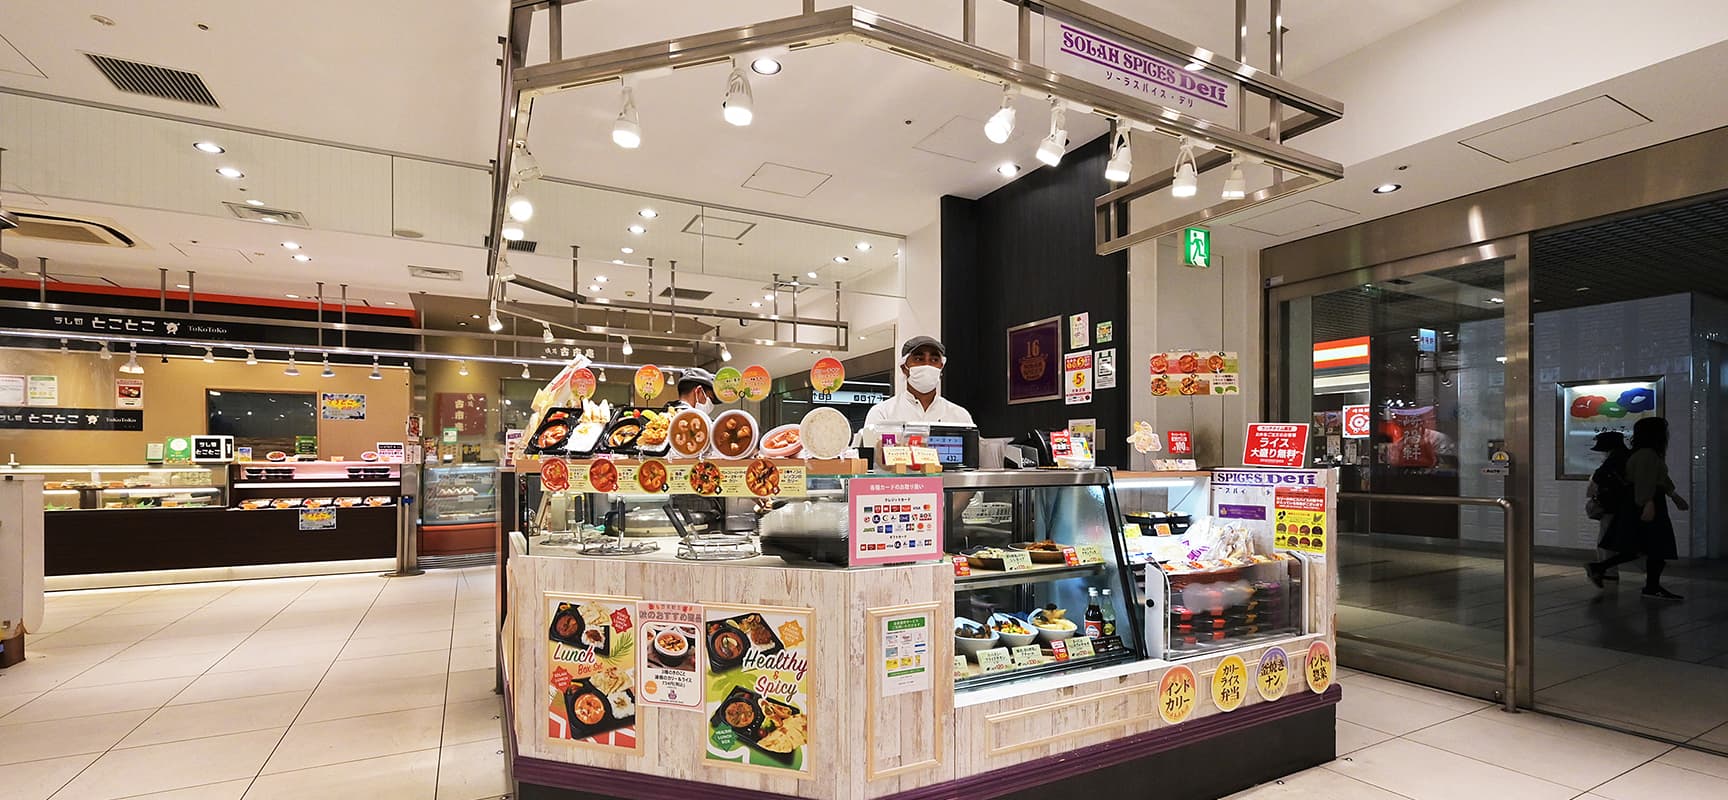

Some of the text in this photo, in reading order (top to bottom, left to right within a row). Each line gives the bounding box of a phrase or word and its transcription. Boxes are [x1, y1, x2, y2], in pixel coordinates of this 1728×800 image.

[1063, 31, 1226, 102] SOLAH SPICES Deli
[91, 316, 156, 332] とことこ
[28, 413, 79, 424] とことこ
[1259, 437, 1289, 448] ライス
[195, 448, 220, 456] とことこ
[1250, 447, 1297, 459] 大盛り無料
[1217, 473, 1263, 484] SPICES
[1267, 474, 1316, 485] Deli
[553, 643, 595, 663] Lunch
[744, 649, 808, 681] Healthy
[1222, 663, 1240, 676] カリー
[1260, 659, 1285, 676] 釜焼き
[1309, 654, 1329, 669] インドの
[1220, 674, 1240, 688] ライス
[1265, 675, 1281, 689] ナン
[1312, 666, 1328, 682] 惣菜
[755, 676, 797, 703] Spicy
[1166, 678, 1191, 697] インド
[1220, 685, 1240, 702] 弁当
[1165, 695, 1190, 712] カリー
